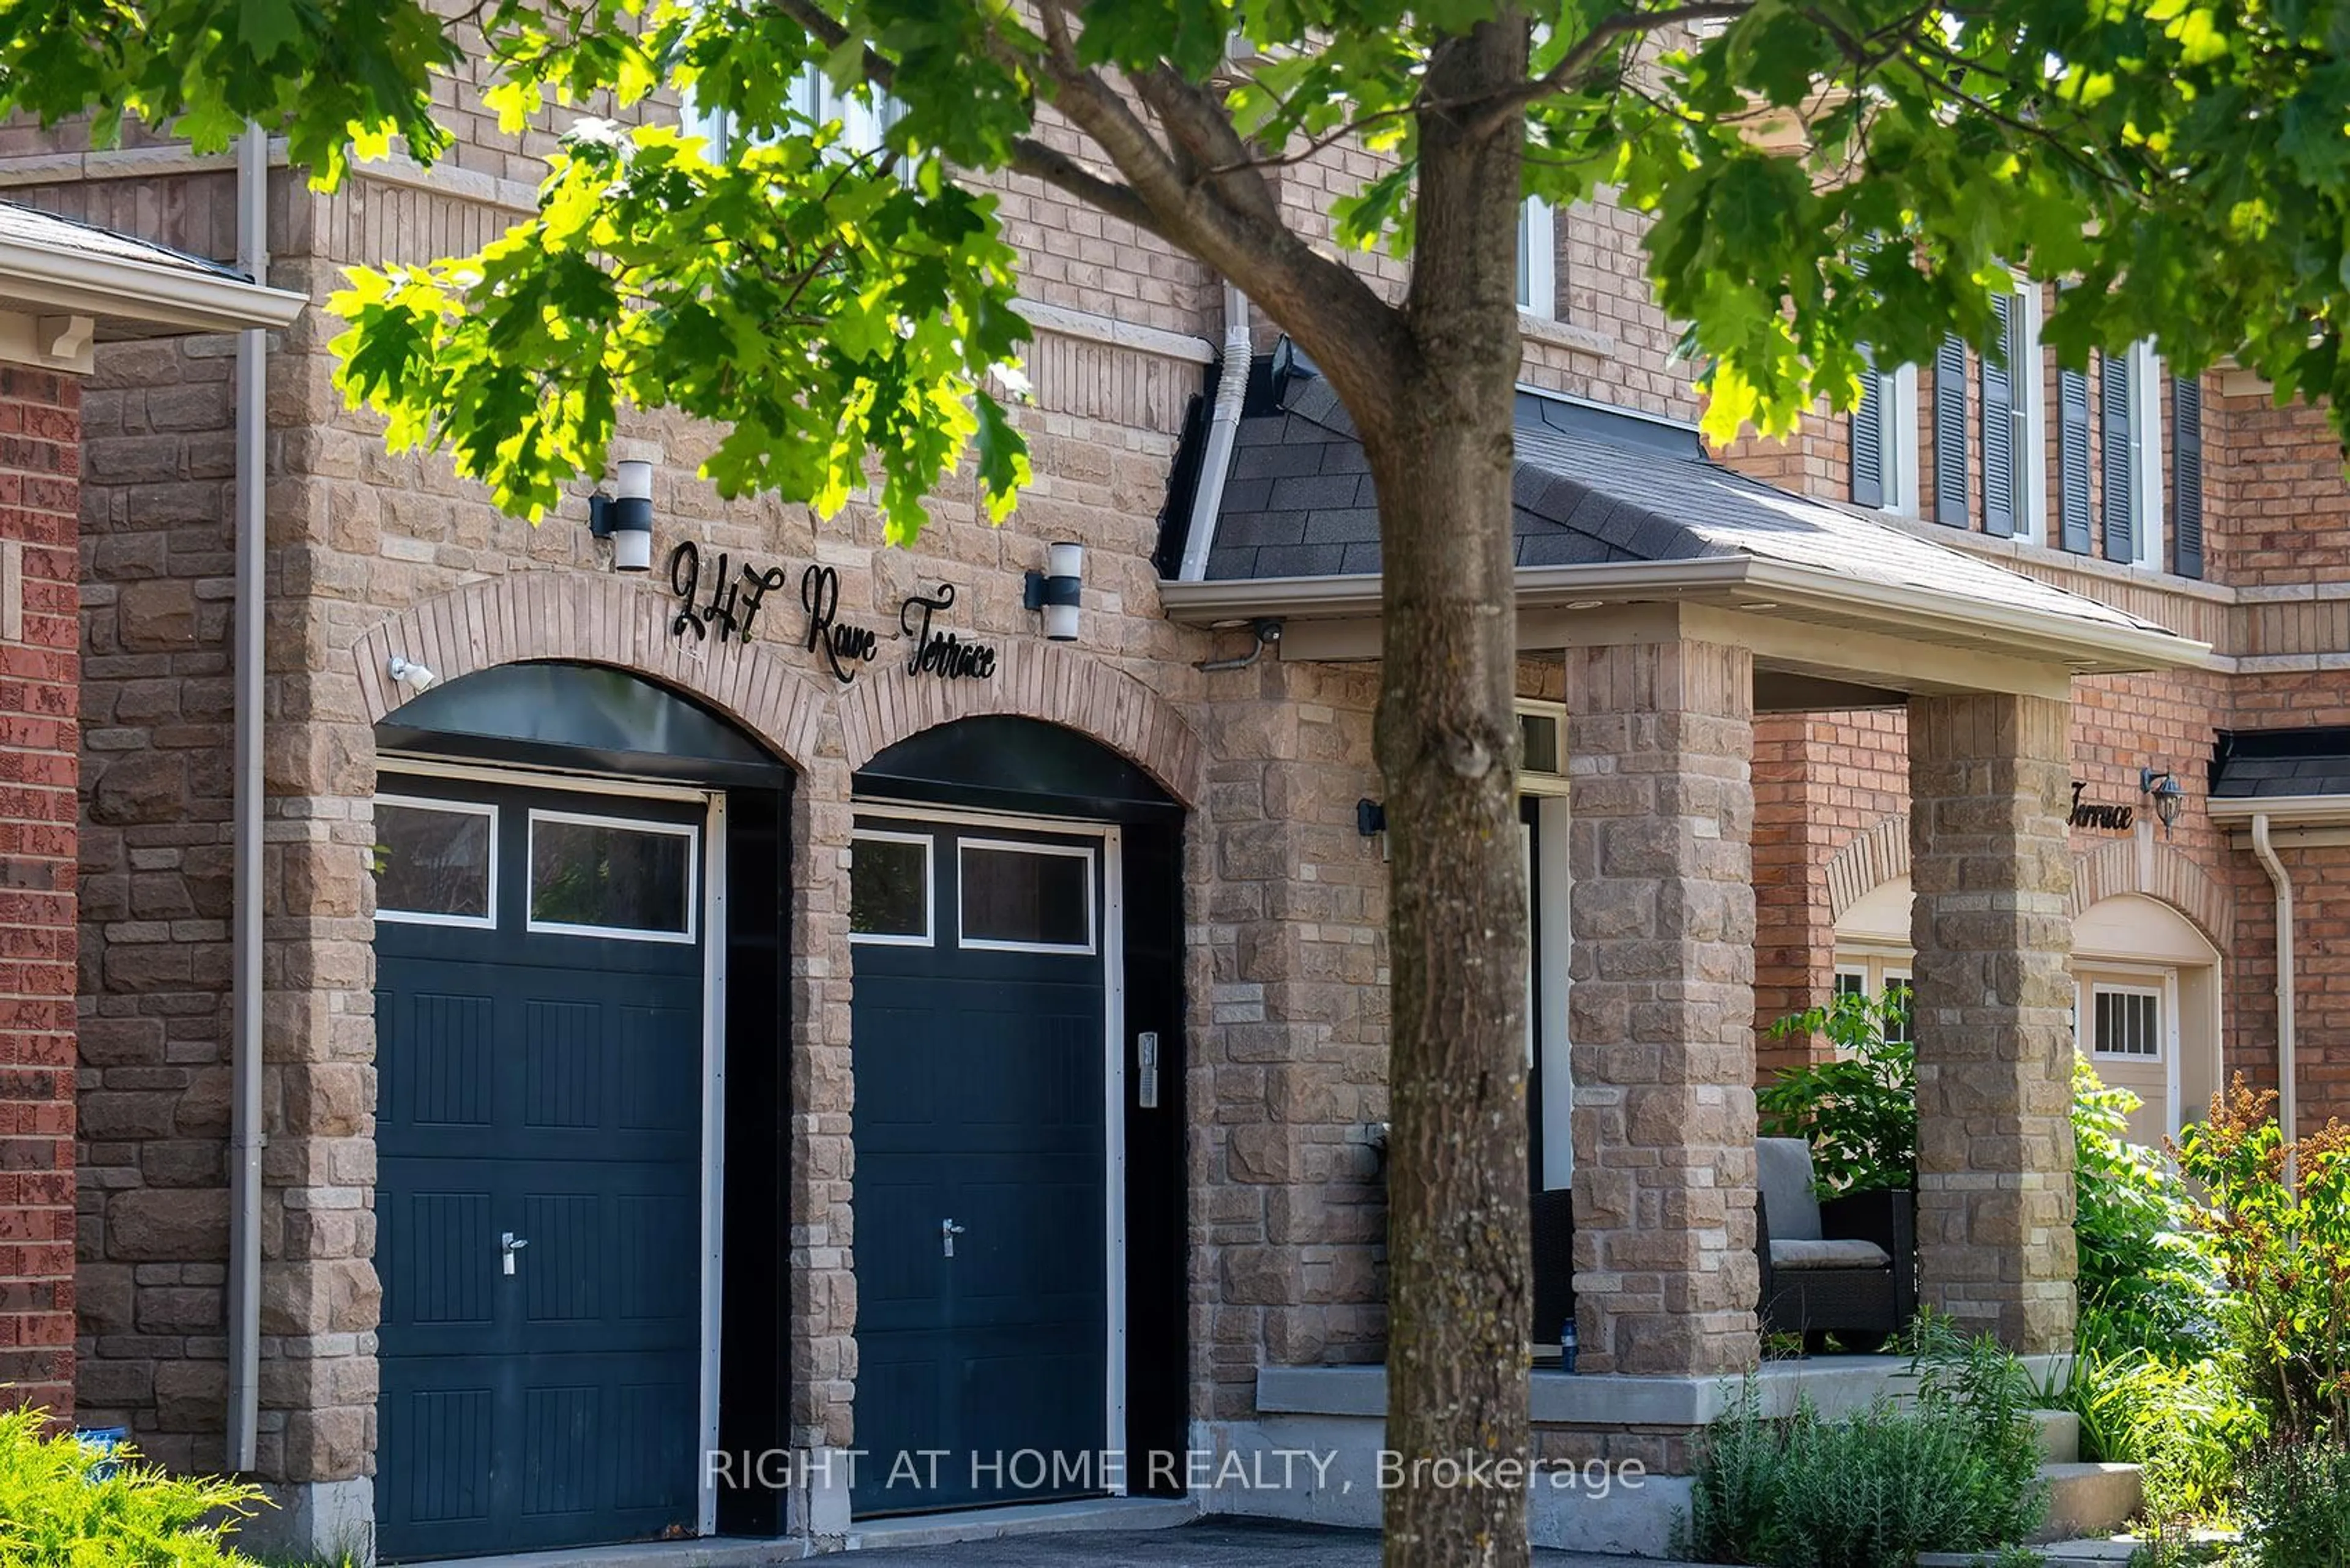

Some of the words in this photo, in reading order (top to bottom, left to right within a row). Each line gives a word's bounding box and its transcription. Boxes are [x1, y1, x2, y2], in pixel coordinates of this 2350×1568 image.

[672, 540, 785, 644] 247
[900, 583, 996, 680] Terrace
[2065, 782, 2133, 830] Terrace
